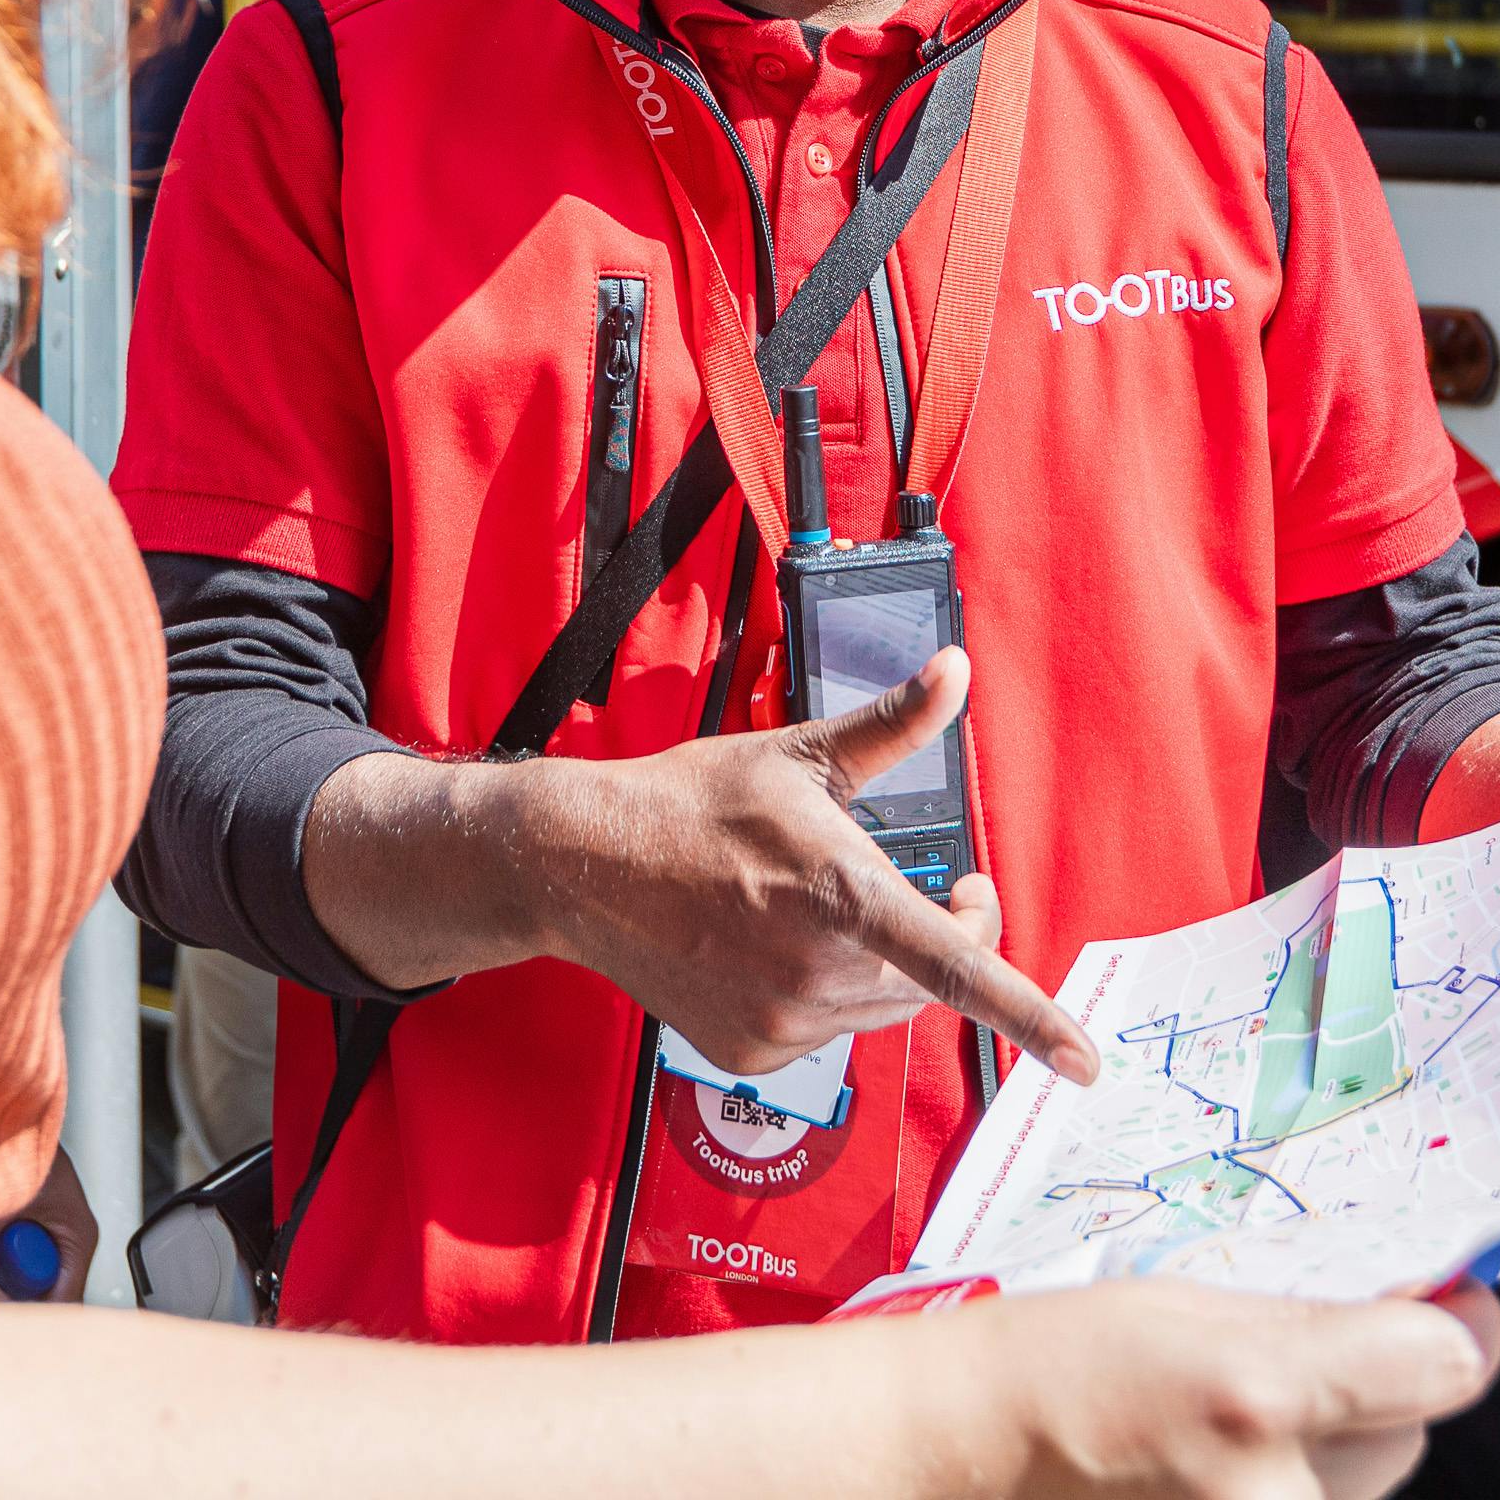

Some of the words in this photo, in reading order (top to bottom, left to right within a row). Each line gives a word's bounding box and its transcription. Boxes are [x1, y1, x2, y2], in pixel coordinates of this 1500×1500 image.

[691, 1132, 765, 1184] Tootbus
[768, 1148, 809, 1184] trip?
[725, 1270, 759, 1284] LONDON
